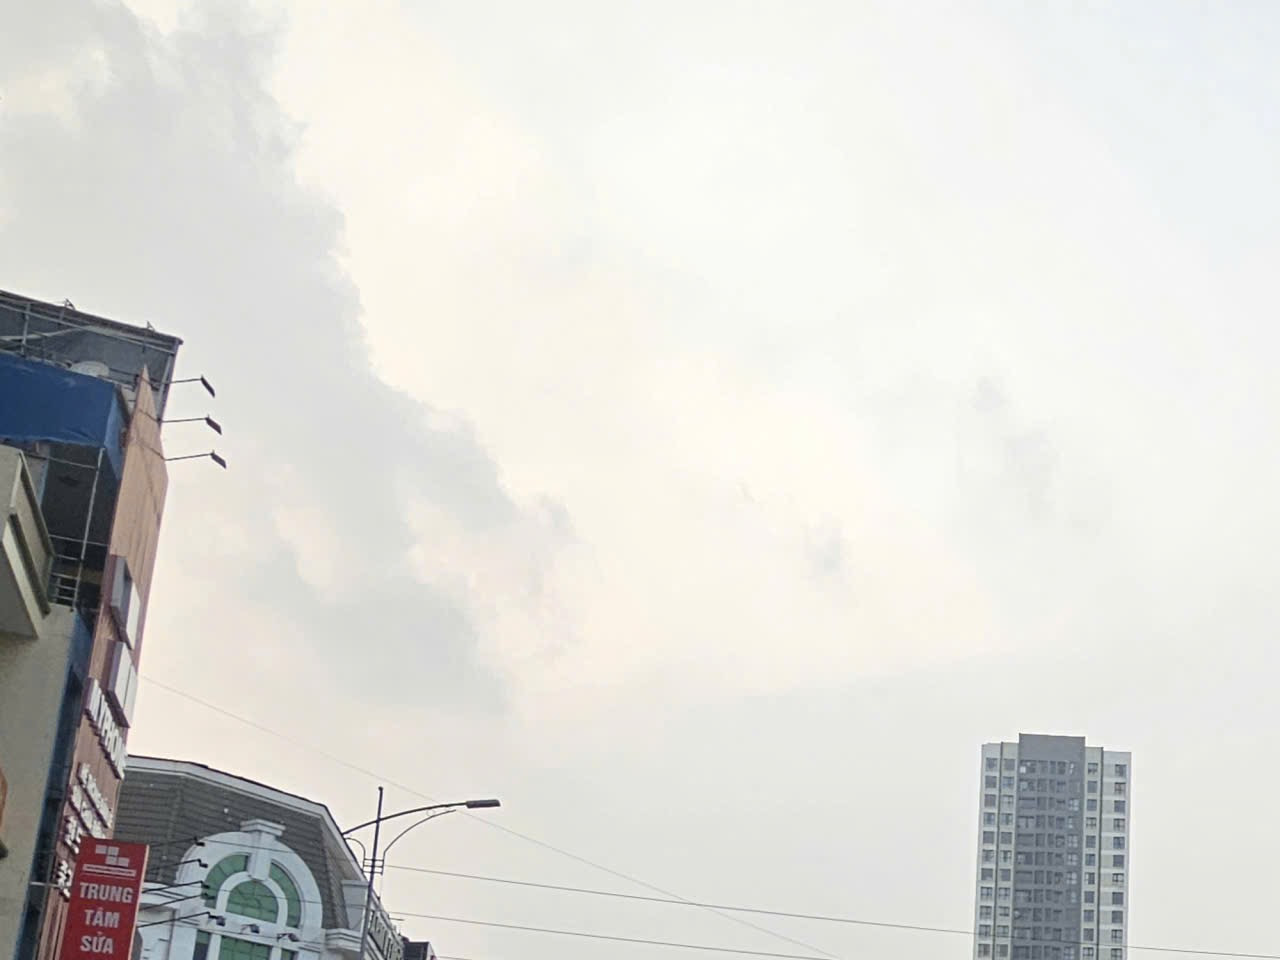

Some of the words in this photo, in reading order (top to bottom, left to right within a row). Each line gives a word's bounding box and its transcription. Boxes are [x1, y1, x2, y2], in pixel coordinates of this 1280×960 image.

[79, 882, 133, 903] TRUNG
[85, 907, 120, 928] TÂM
[80, 931, 113, 955] SỬA
